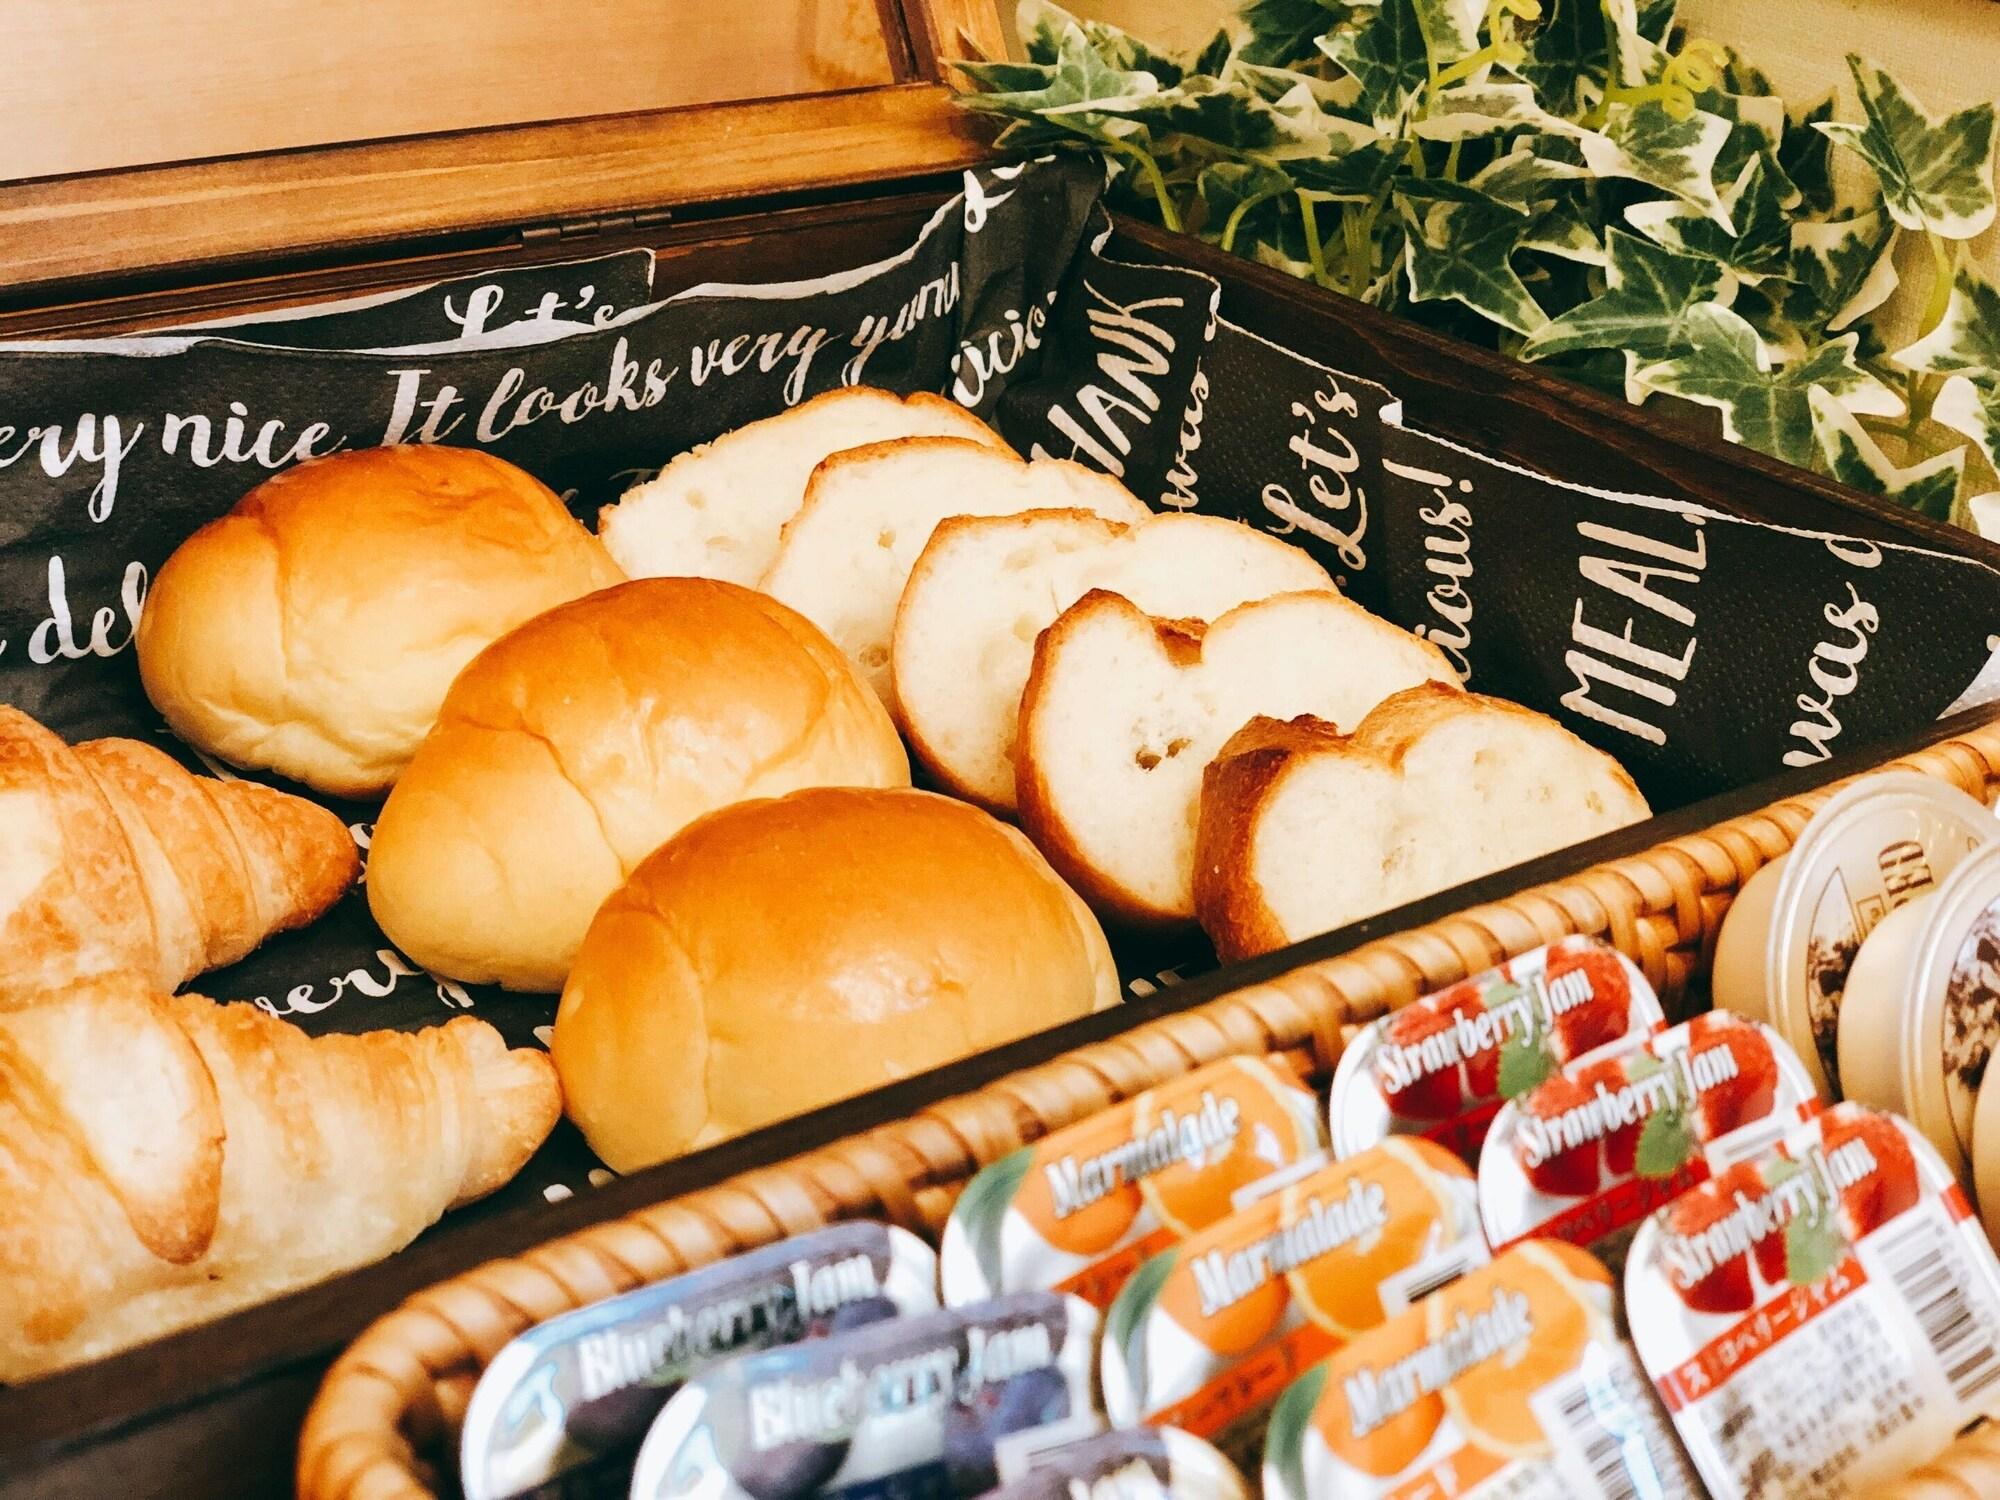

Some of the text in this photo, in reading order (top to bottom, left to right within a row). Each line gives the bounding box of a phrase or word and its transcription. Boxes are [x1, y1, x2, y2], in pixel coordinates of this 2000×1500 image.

[161, 401, 348, 468] nice
[386, 368, 465, 445] It
[476, 337, 682, 443] looks
[690, 320, 842, 406] very
[1160, 355, 1210, 512] was
[1261, 374, 1369, 571] Let's
[1560, 513, 1706, 747] MEAL
[1782, 581, 1880, 768] was
[1375, 967, 1596, 1095] Strawberry Jam
[1044, 1091, 1241, 1220] Marmalade
[1515, 1072, 1678, 1169] Strawberry
[1673, 1043, 1741, 1113] Jam
[1190, 1176, 1388, 1317] Marmalade
[1660, 1170, 1821, 1290] Strawberry
[1808, 1137, 1878, 1210] Jam
[787, 1253, 879, 1323] Jam
[956, 1322, 1050, 1406] Jam
[1343, 1286, 1535, 1439] Marmalade
